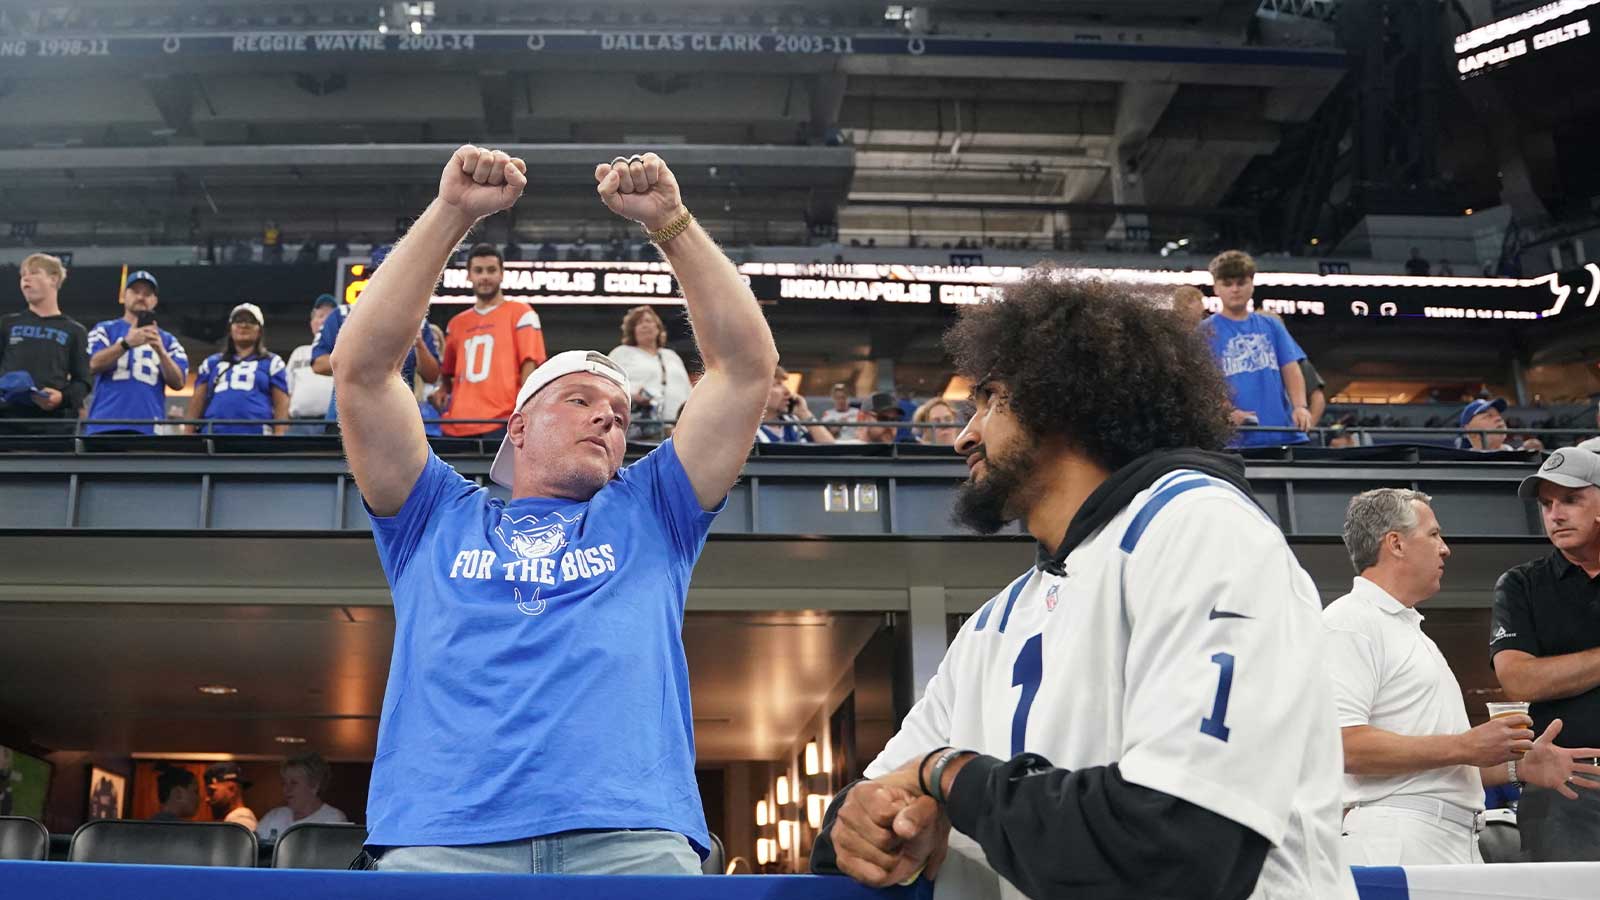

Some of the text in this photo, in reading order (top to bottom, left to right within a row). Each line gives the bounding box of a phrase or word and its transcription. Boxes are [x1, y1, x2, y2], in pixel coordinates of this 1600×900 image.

[38, 40, 110, 56] 1998-11
[232, 34, 475, 52] REGGIE WAYNE 2001-14
[600, 34, 853, 53] DALLAS CLARK 2003-11
[1533, 19, 1590, 49] COLTS
[443, 269, 671, 293] INNAPOLIS COLTS
[781, 279, 931, 302] INDIANAPOLIS
[11, 325, 69, 346] COLTS
[112, 337, 161, 386] 18
[464, 333, 495, 383] 10
[214, 359, 259, 393] 18
[449, 543, 616, 586] FOR THE BOSS
[1010, 632, 1043, 758] 1
[1200, 651, 1235, 743] 1
